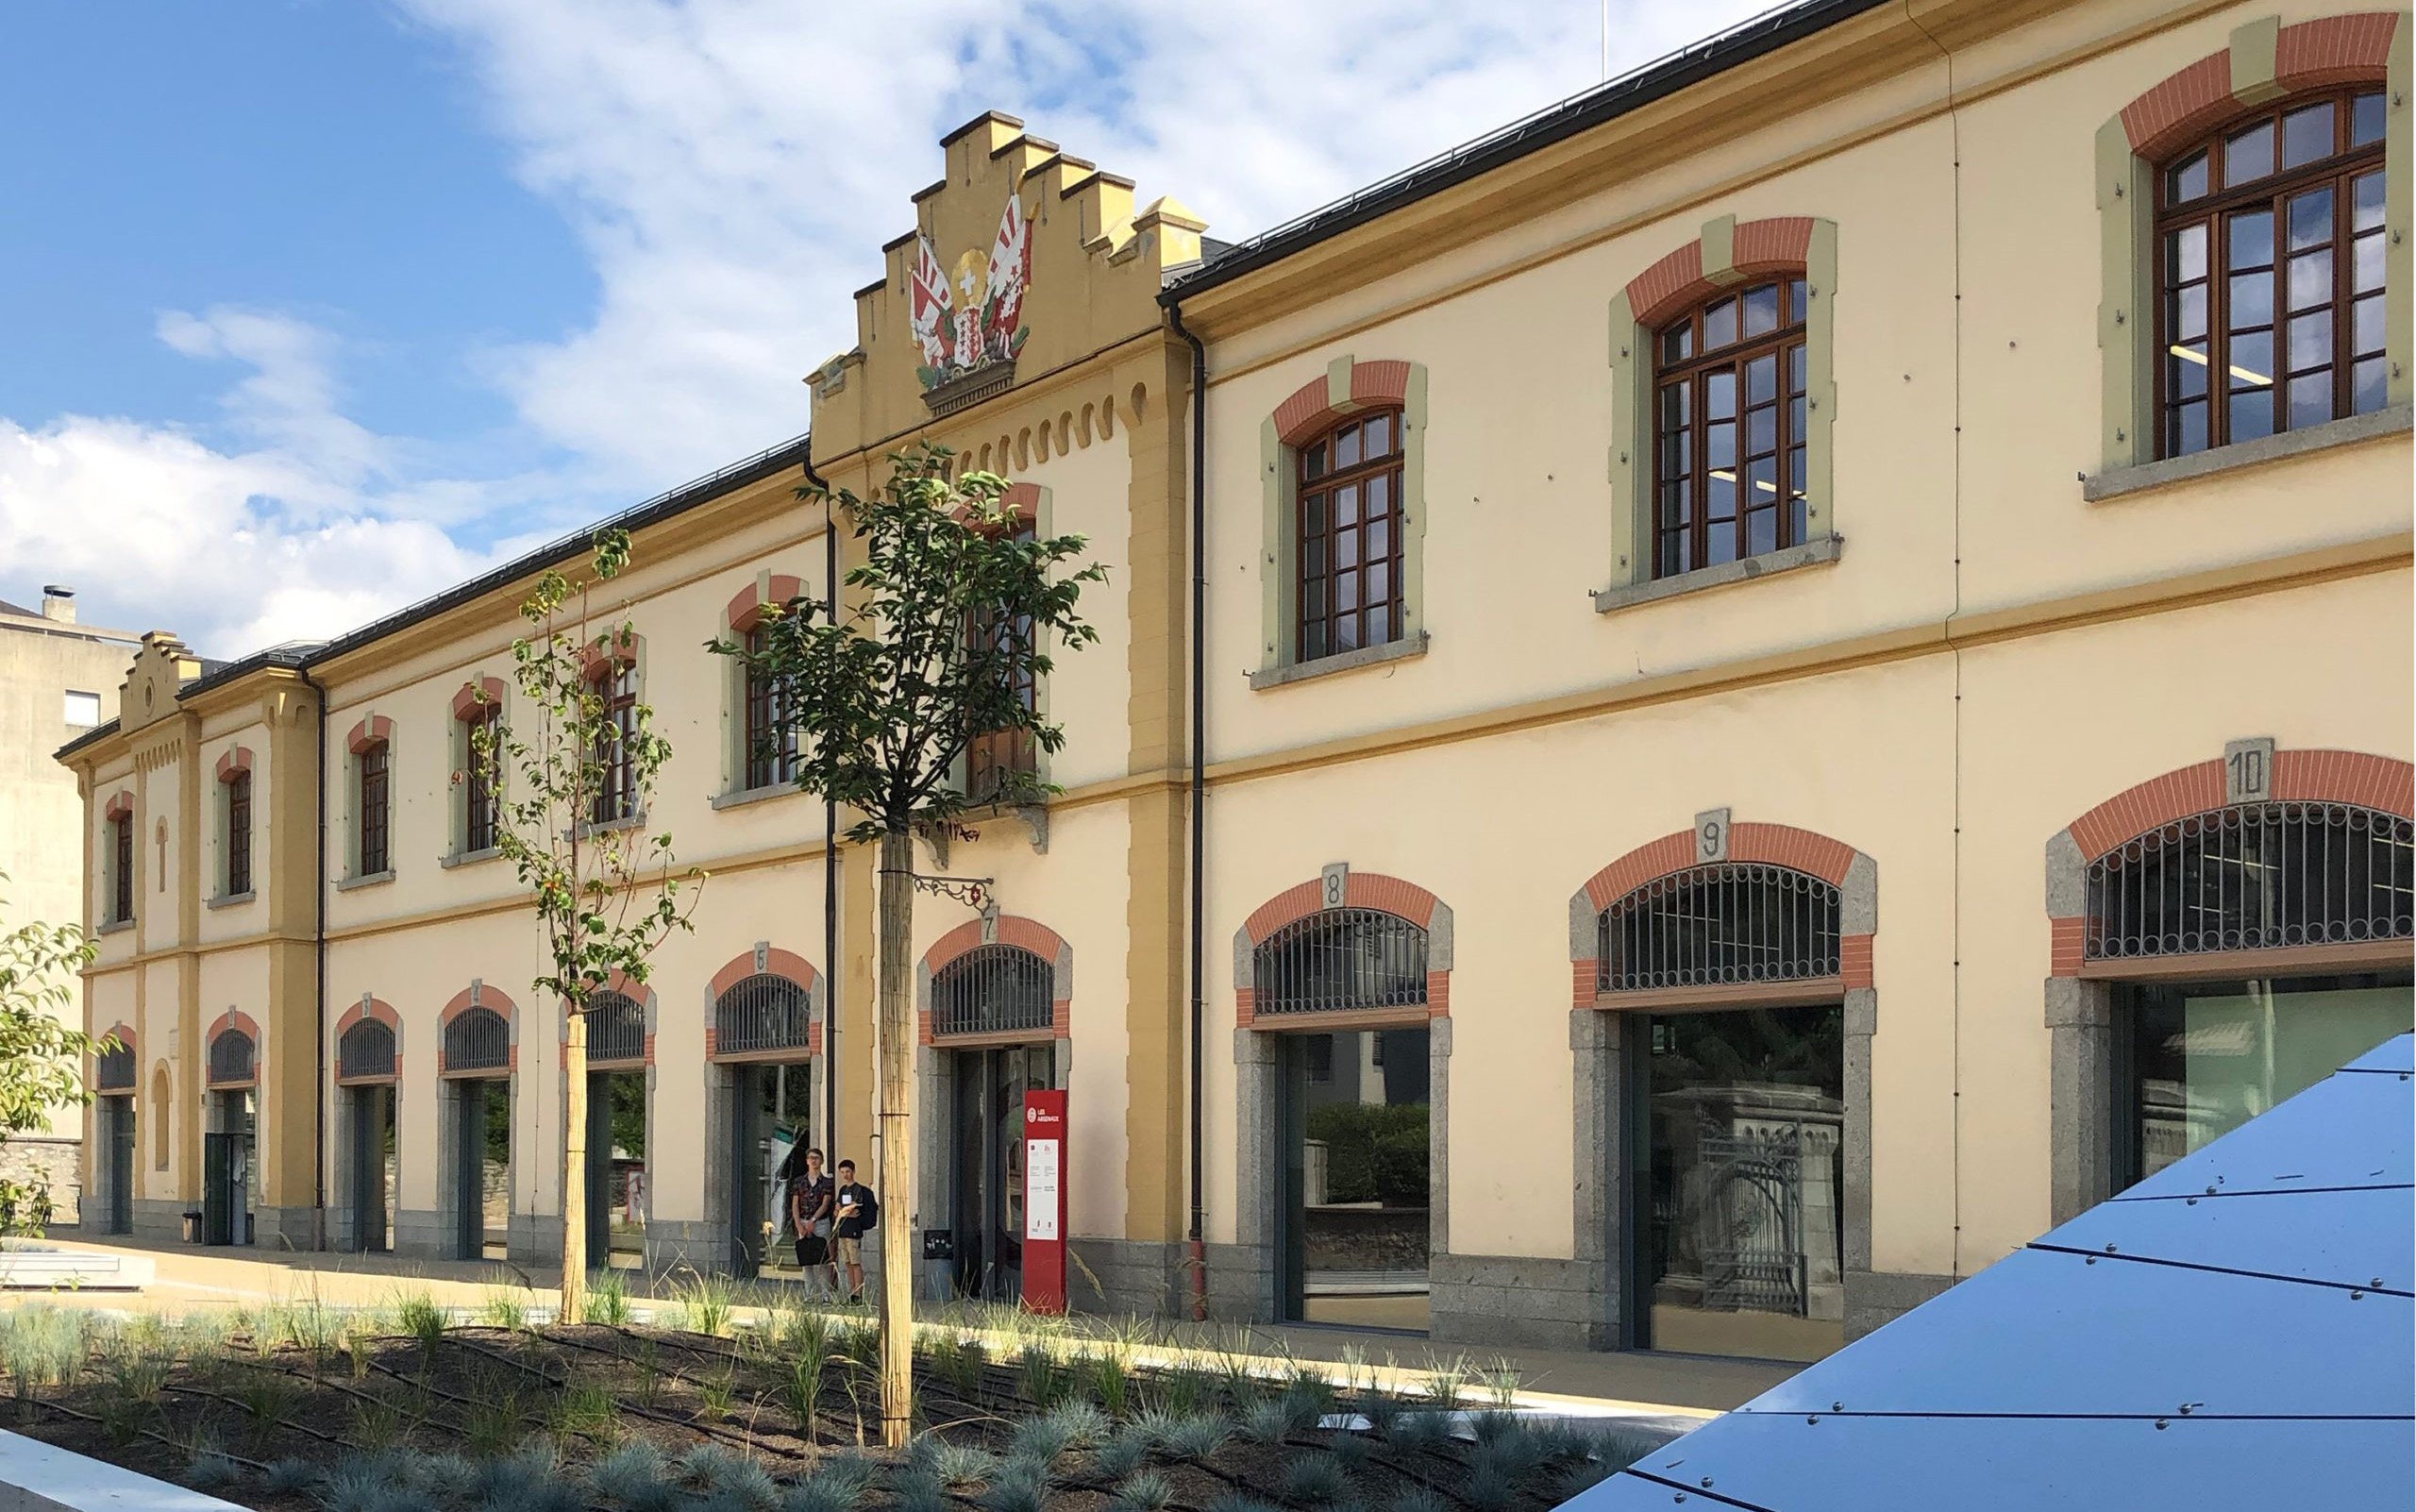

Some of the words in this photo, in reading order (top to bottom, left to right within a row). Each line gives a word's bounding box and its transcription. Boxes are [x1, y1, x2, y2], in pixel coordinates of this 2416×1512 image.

[2228, 749, 2262, 796] 10
[1703, 822, 1720, 857] 9
[1328, 874, 1339, 904] 8
[984, 916, 994, 940] 7
[757, 949, 765, 970] 6
